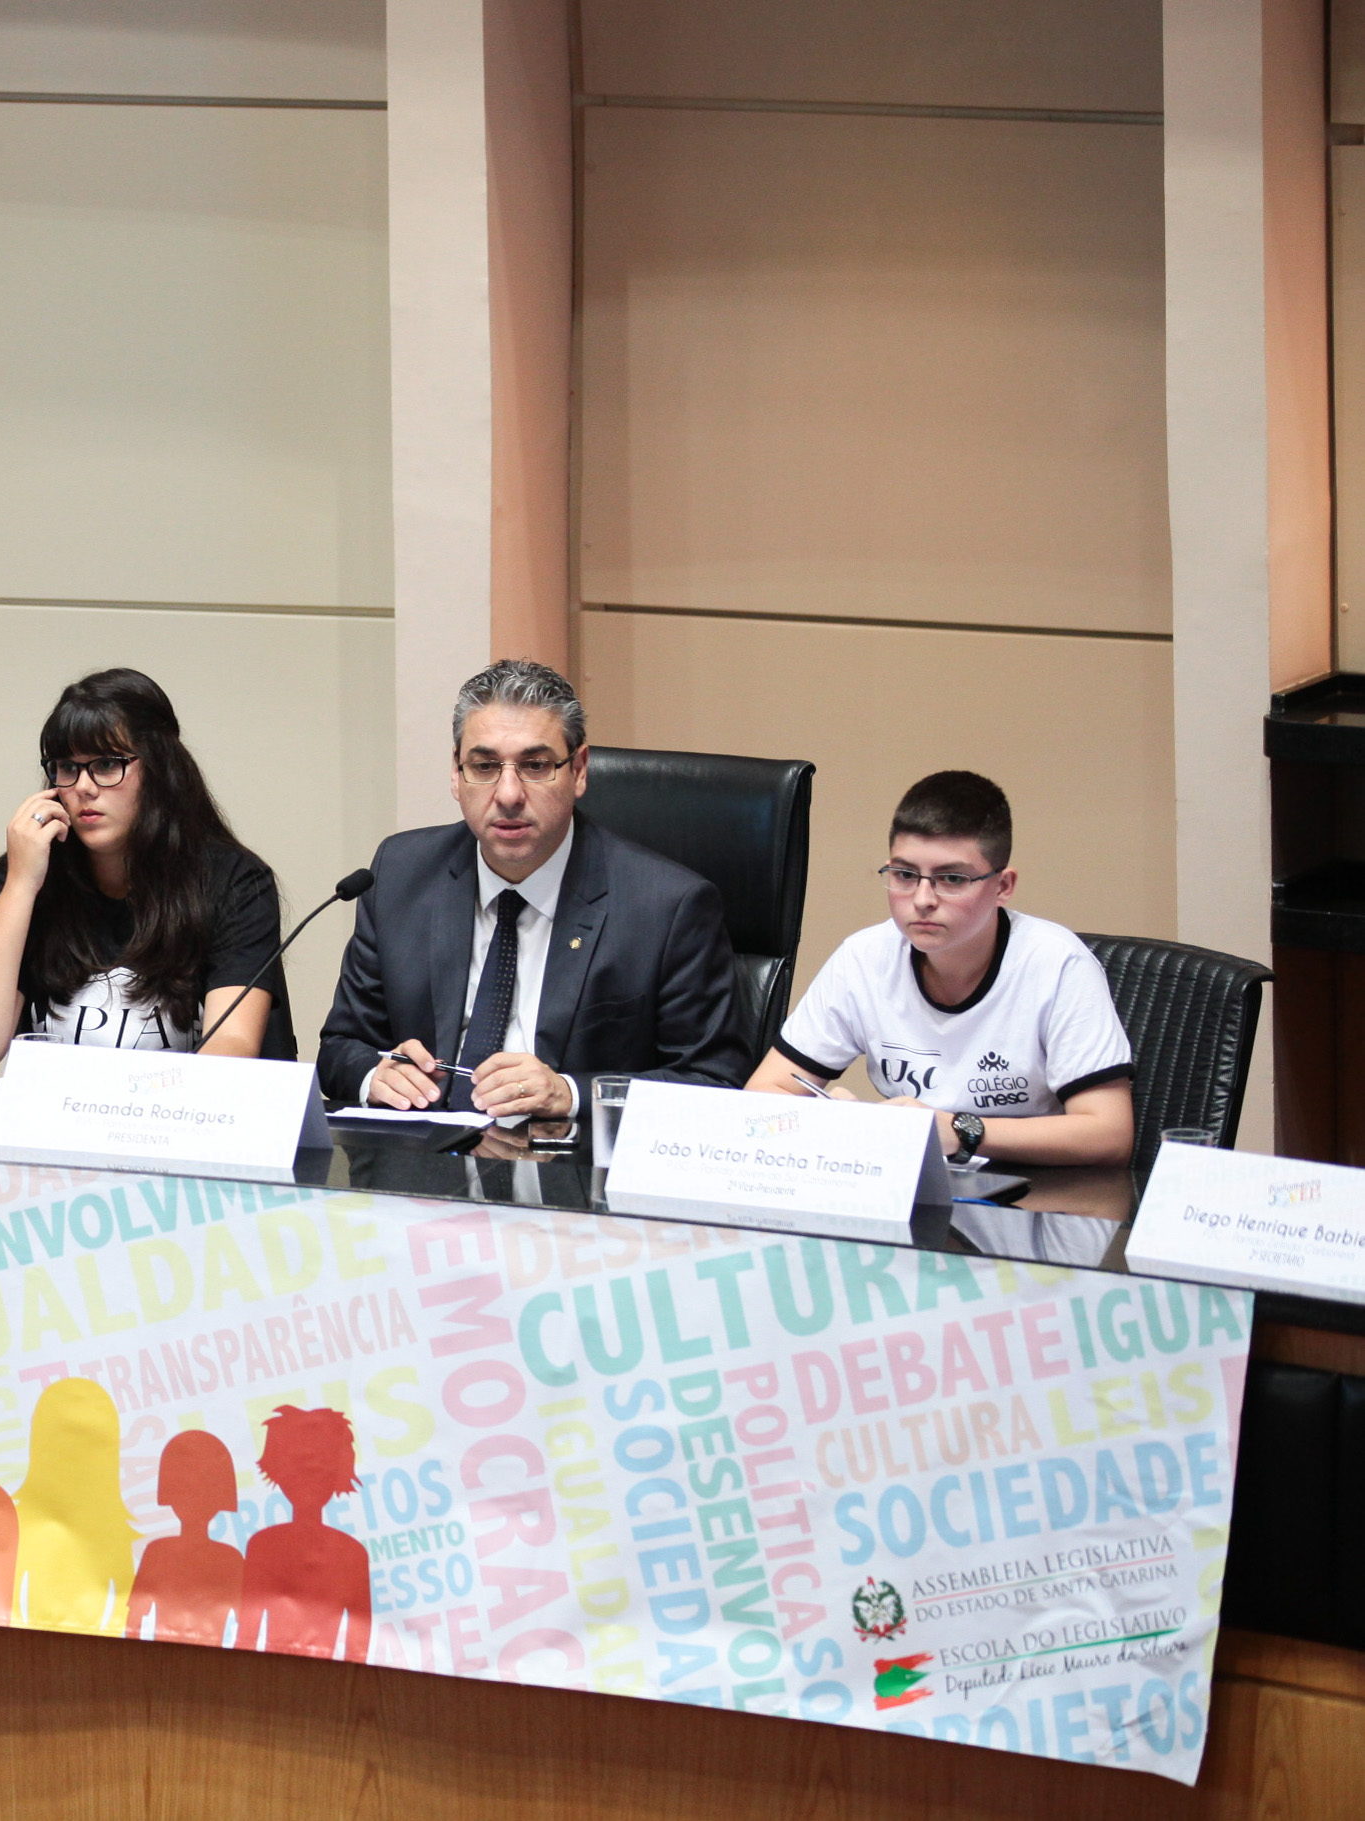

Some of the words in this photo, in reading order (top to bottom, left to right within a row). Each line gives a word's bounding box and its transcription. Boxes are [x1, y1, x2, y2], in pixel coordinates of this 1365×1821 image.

[62, 1097, 144, 1118] Fernanda
[150, 1104, 235, 1125] Rodrigues
[967, 1075, 1028, 1093] COLÉGIO
[974, 1091, 1029, 1109] unesc
[107, 1131, 170, 1145] PRESIDENTA
[649, 1139, 692, 1158] João
[698, 1143, 749, 1164] Victor
[754, 1149, 809, 1170] Rocha
[815, 1154, 883, 1178] Trombim
[1184, 1204, 1231, 1228] Diego
[1236, 1213, 1309, 1239] Henrique
[518, 1237, 985, 1388] CULTURA
[80, 1288, 418, 1414] TRANSPARÊNCIA
[791, 1302, 1071, 1426] DEBATE
[1071, 1284, 1254, 1370] IGUA
[815, 1394, 1043, 1489] CULTURA
[1047, 1361, 1215, 1448] LEIS
[724, 1362, 828, 1642] POLÍTICA
[834, 1431, 1223, 1566] SOCIEDADE
[668, 1368, 791, 1717] DESENVOL
[912, 1558, 1038, 1599] ASSEMBLEIA
[1043, 1534, 1173, 1574] LEGISLATIVA
[915, 1599, 943, 1623] DO
[947, 1590, 1009, 1617] ESTADO
[1015, 1587, 1036, 1606] DE
[1042, 1576, 1096, 1600] SANTA
[1098, 1563, 1179, 1589] CATARINA
[939, 1637, 1019, 1668] ESCOLA
[1022, 1628, 1055, 1653] DO
[1062, 1606, 1187, 1645] LEGISLATIVO
[945, 1665, 1013, 1700] Deputado
[1062, 1653, 1111, 1675] Mauro
[1116, 1643, 1137, 1664] da
